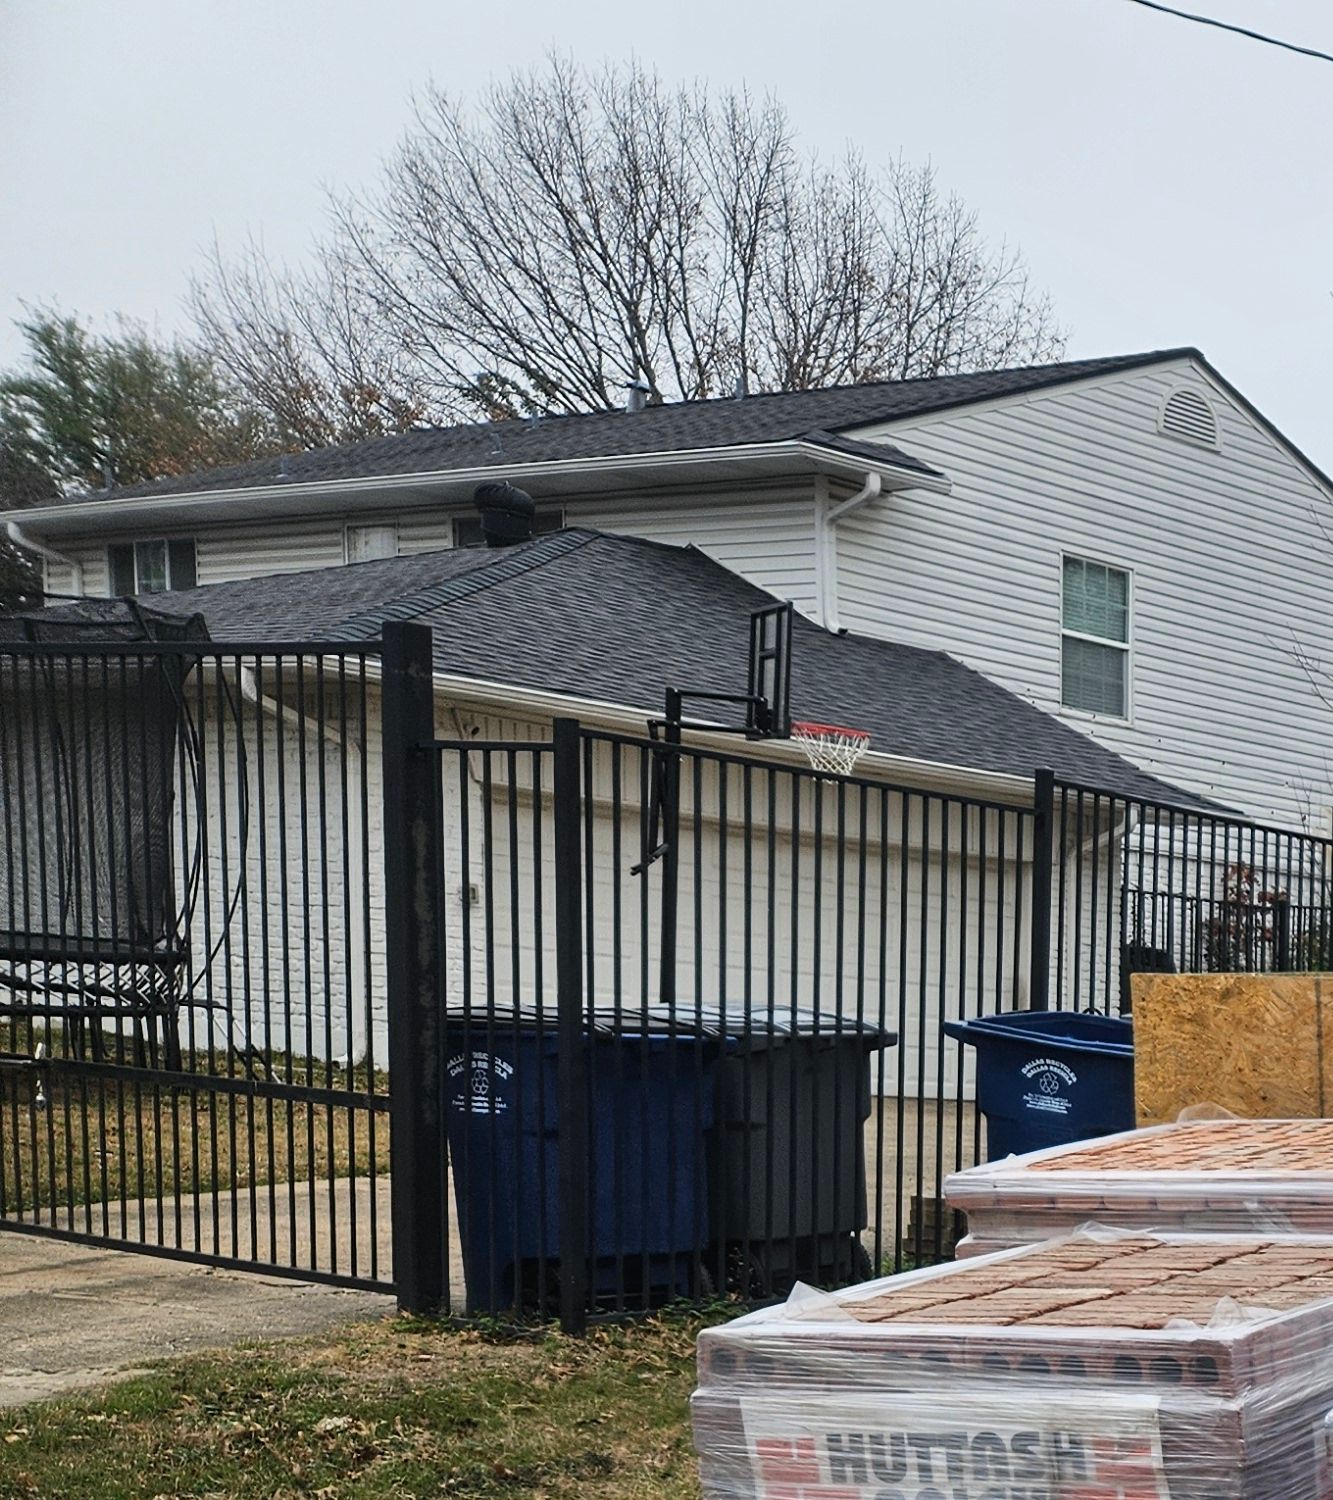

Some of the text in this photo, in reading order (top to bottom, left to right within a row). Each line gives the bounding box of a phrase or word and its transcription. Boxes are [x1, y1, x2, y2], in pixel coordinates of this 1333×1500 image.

[1021, 1059, 1077, 1082] DALLAS RECYCLES
[1026, 1065, 1049, 1078] DALLAS
[826, 1432, 1086, 1484] HUTTASH
